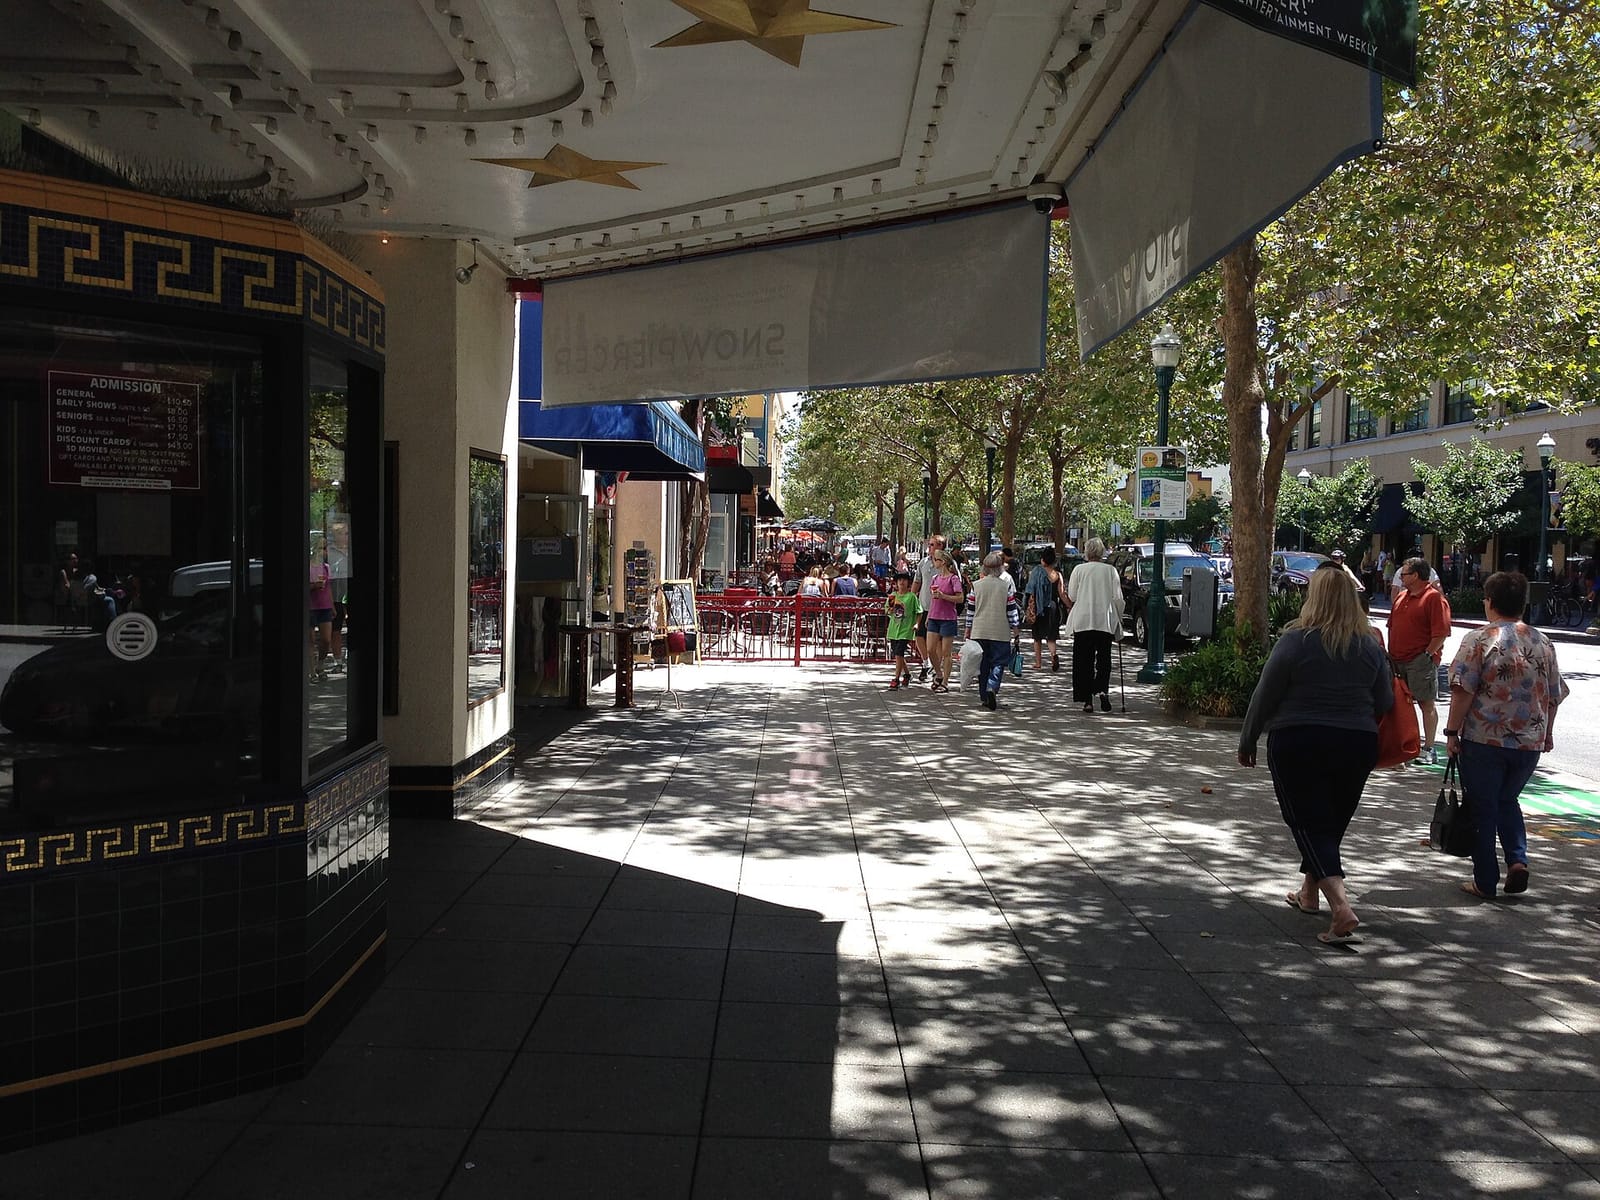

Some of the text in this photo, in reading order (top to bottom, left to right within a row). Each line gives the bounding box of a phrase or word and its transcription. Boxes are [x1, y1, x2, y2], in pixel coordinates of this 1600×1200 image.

[1336, 30, 1378, 57] WEEKLY
[90, 377, 161, 394] ADMISSION
[56, 387, 96, 399] GENERAL
[56, 398, 84, 407] EARLY
[85, 400, 118, 410] SHOWS
[56, 410, 94, 421] SENIORS
[56, 424, 77, 434] KIDS
[56, 434, 101, 445] DISCOUNT
[102, 437, 131, 447] CARDS
[78, 446, 109, 454] MOVIES
